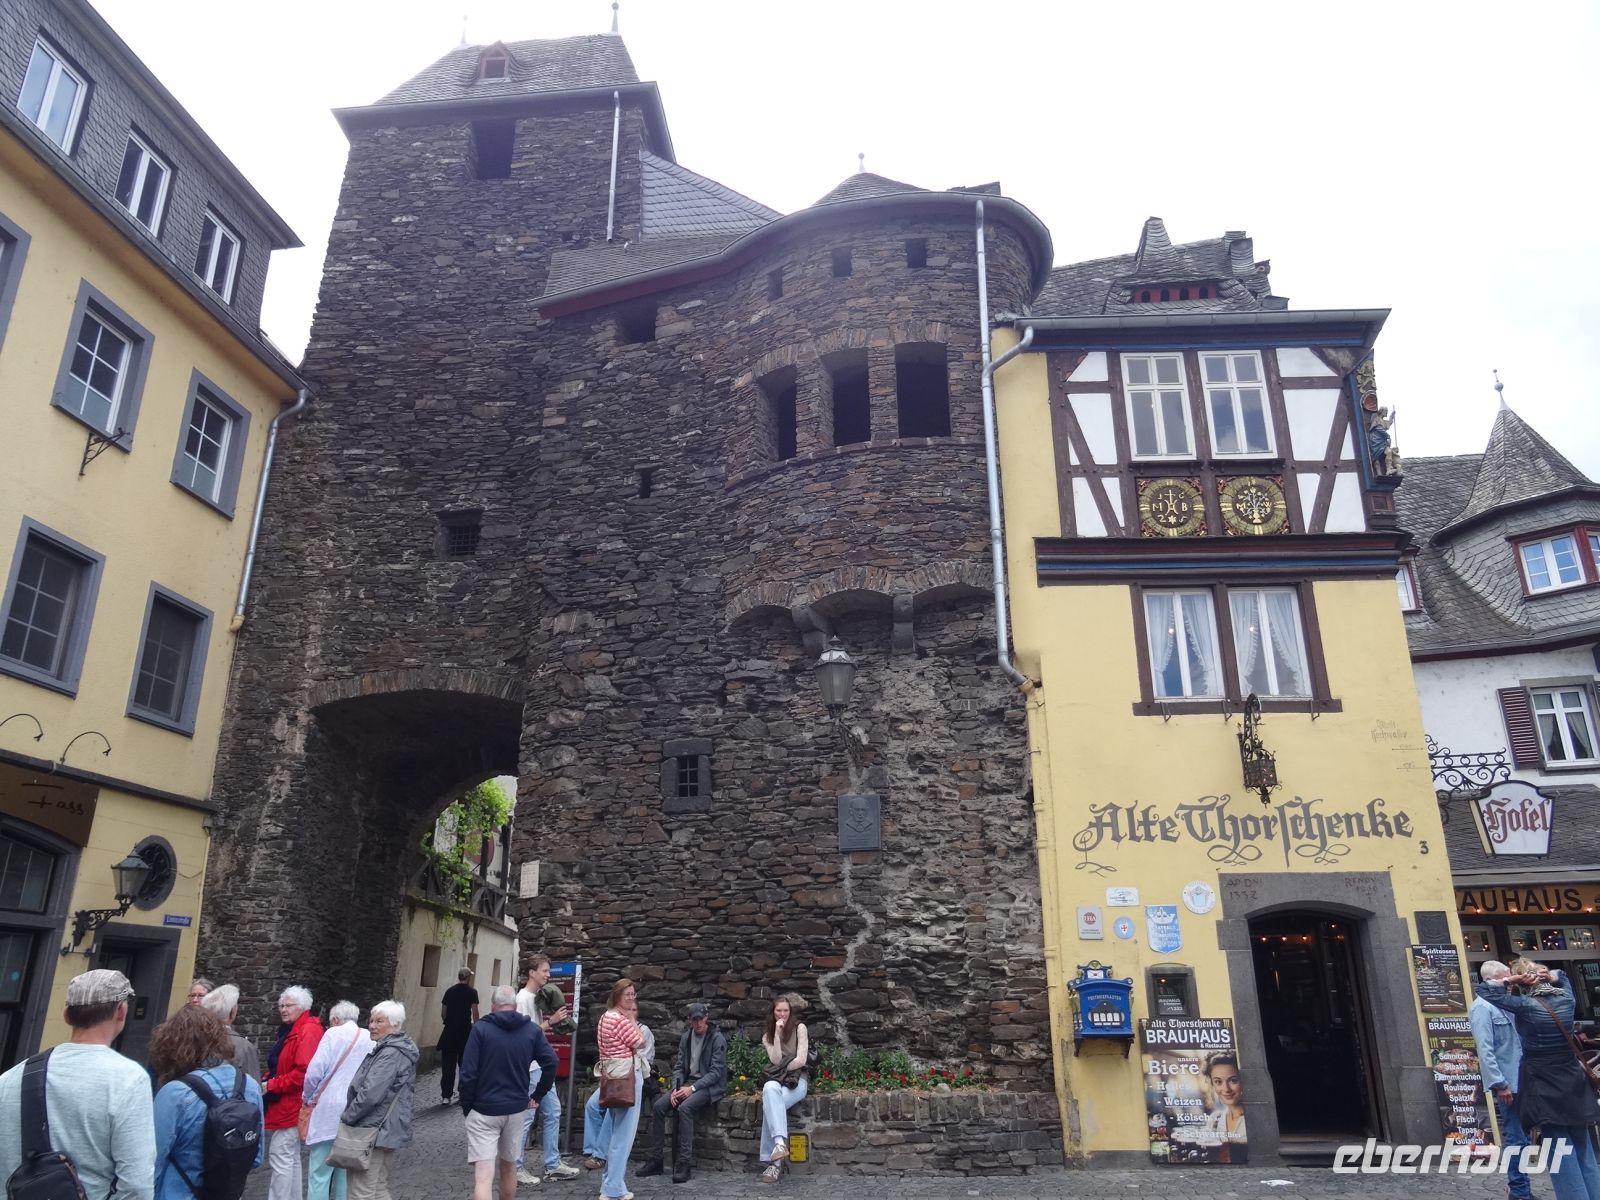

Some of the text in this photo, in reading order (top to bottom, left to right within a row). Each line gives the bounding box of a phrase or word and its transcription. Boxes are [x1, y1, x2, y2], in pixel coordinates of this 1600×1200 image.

[1482, 798, 1550, 843] Hotel
[1073, 800, 1181, 864] Alte
[1419, 841, 1429, 855] 3
[1151, 1018, 1221, 1029] alte Thorschenke
[1428, 1022, 1472, 1030] BRAUHAUS
[1145, 1029, 1231, 1044] BRAUHAUS
[1148, 1060, 1200, 1075] Biere
[1163, 1096, 1203, 1106] Weizen
[1176, 1113, 1210, 1122] Kölsch
[1456, 1126, 1477, 1135] Tapas
